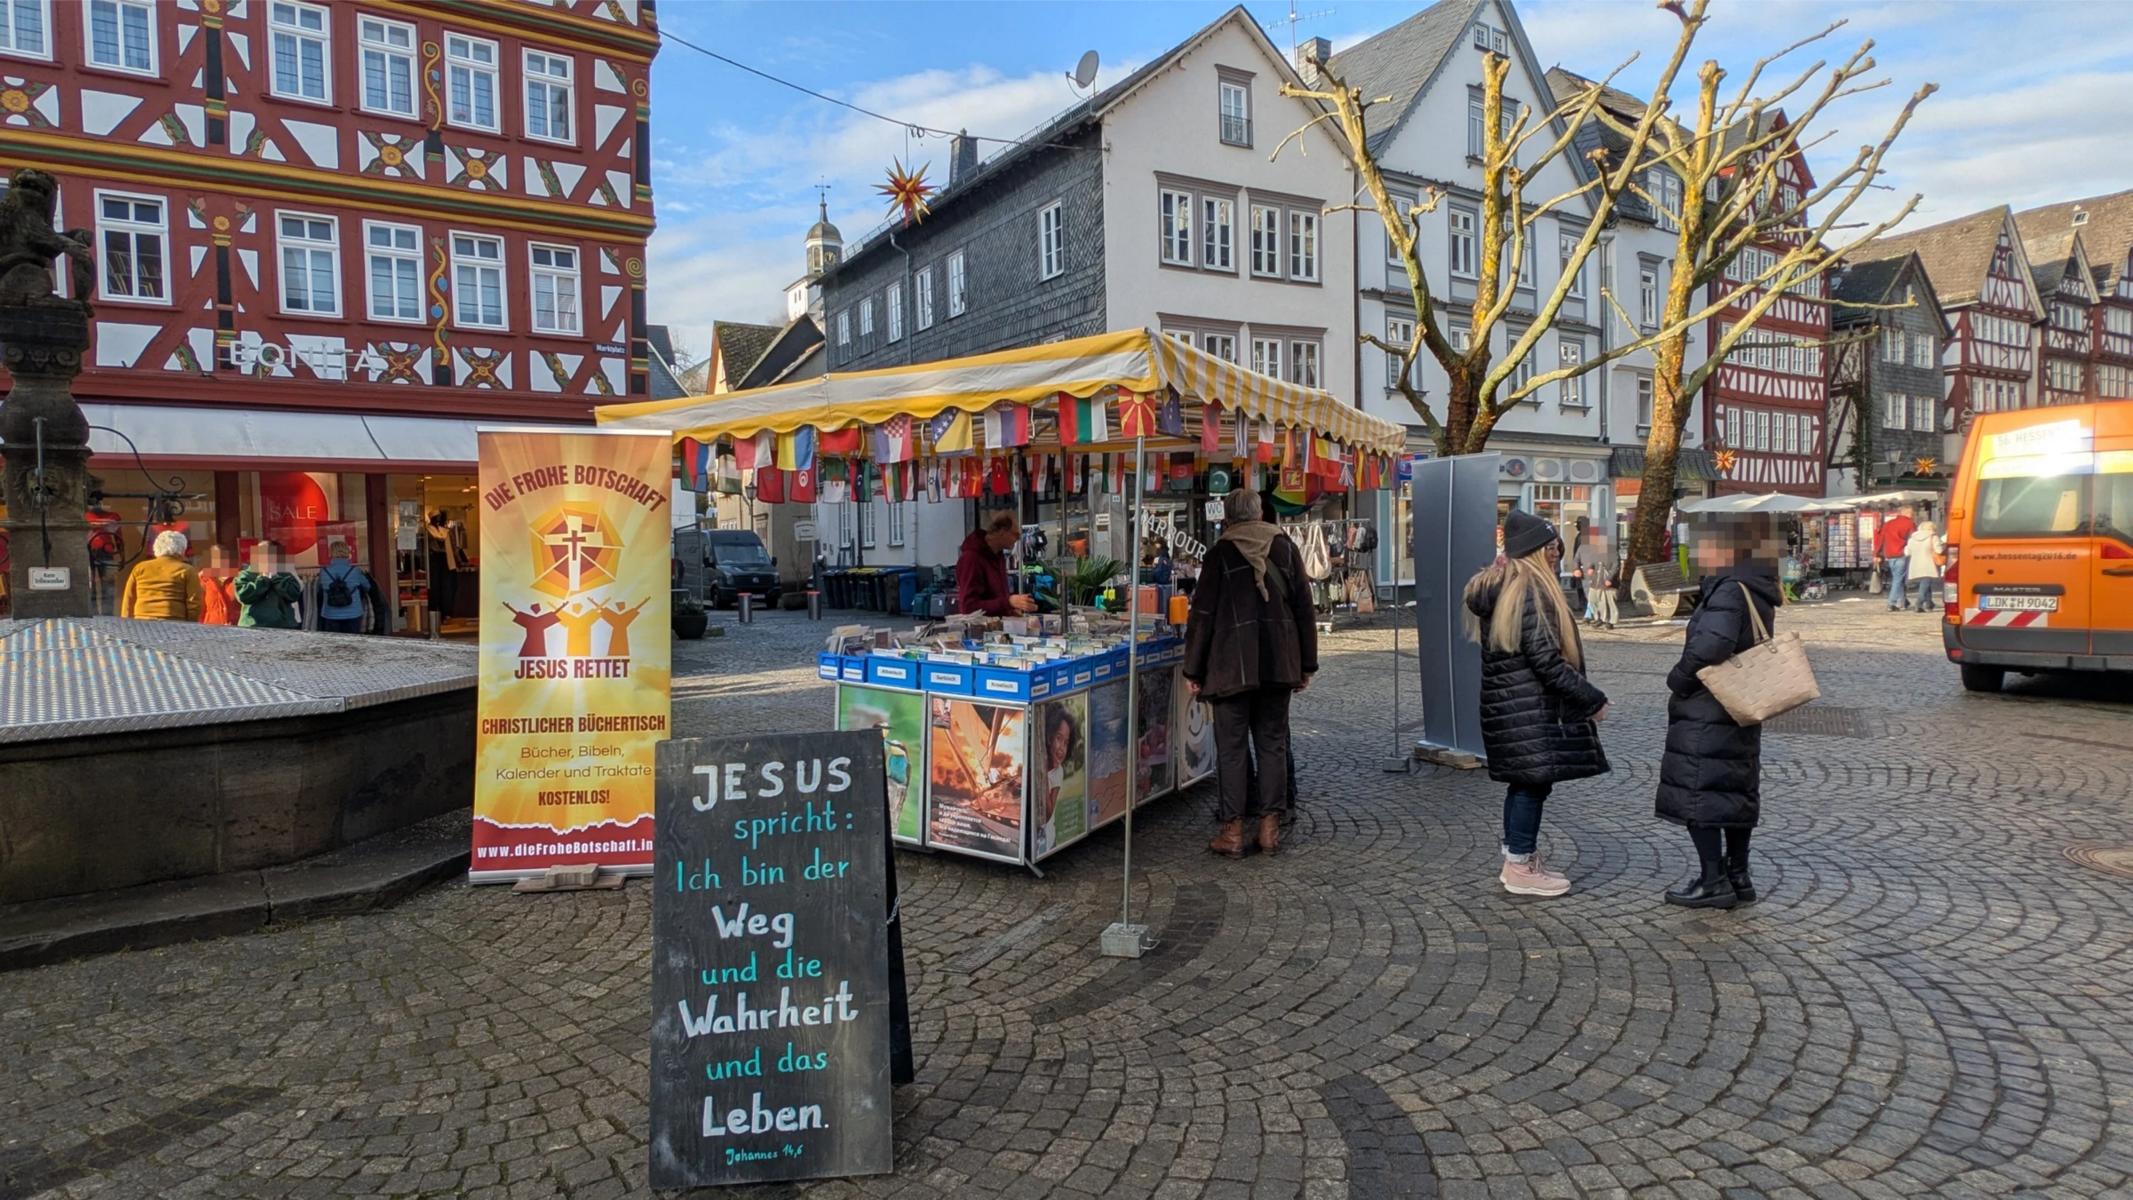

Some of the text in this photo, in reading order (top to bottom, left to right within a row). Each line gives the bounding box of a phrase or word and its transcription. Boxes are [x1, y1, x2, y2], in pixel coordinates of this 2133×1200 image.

[484, 464, 667, 512] DIE FROHE BOTSCHAFT
[270, 505, 317, 520] SALE
[1208, 503, 1223, 514] WC
[2027, 598, 2056, 608] 9042
[514, 658, 630, 679] JESUS RETTET
[482, 713, 666, 734] CHRISTLICHER BÜCHERTISCH
[521, 745, 625, 759] Bücher, Bibeln,
[496, 764, 652, 780] Kalender und Traktate
[692, 756, 851, 812] JESUS
[538, 789, 610, 806] KOSTENLOS!
[734, 800, 853, 850] spricht:
[477, 838, 653, 858] www.dieFroheBotschaft.in
[675, 847, 850, 893] Ich bin der
[711, 902, 795, 949] Weg
[701, 948, 823, 985] und die
[678, 980, 859, 1039] Wahrheit
[706, 1041, 828, 1080] und das
[702, 1091, 830, 1137] Leben.
[725, 1144, 804, 1166] Johannes 14,6
